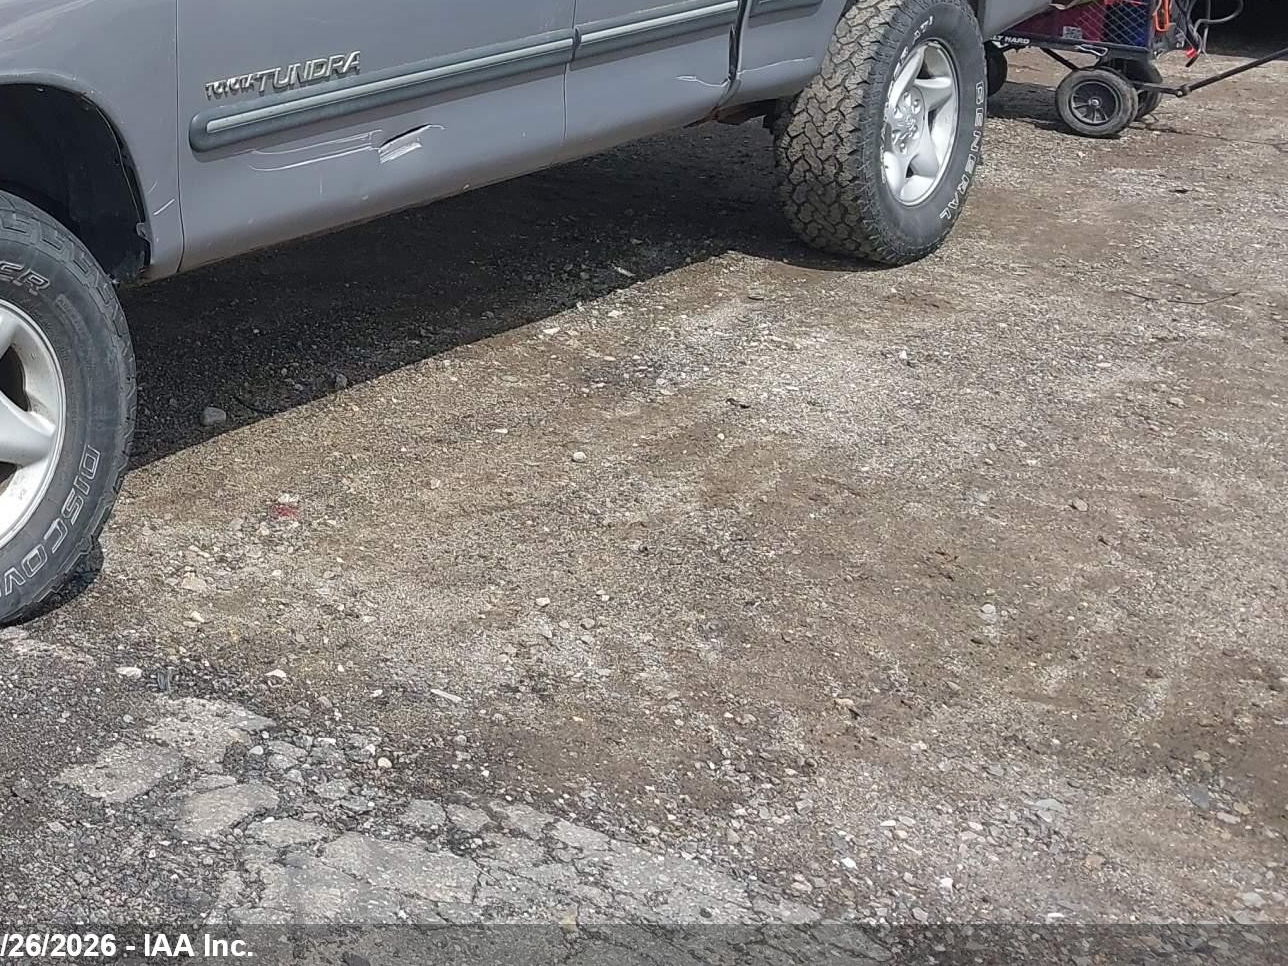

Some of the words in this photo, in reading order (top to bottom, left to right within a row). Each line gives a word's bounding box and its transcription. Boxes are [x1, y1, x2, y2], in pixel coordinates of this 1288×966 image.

[1004, 36, 1031, 44] HARD
[255, 50, 362, 94] TUNDRA
[939, 81, 985, 220] GENERAL
